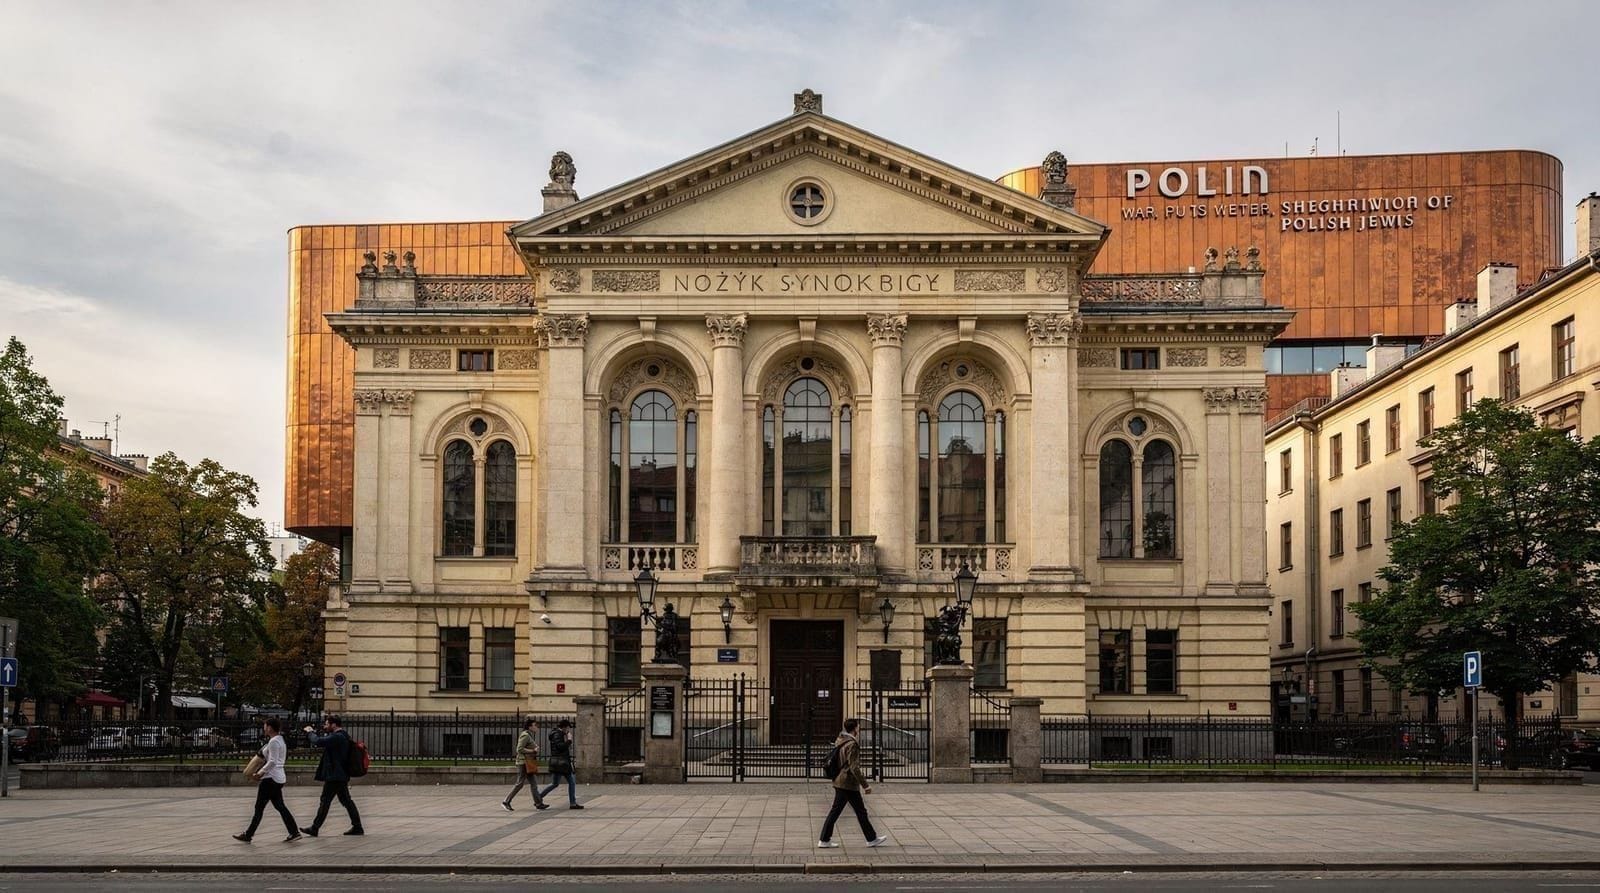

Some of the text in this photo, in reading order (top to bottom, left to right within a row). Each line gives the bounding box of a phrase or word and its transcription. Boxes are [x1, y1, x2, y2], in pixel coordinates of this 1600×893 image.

[1427, 195, 1453, 209] OF
[1281, 214, 1414, 231] POLISH JEWIS
[1467, 657, 1477, 683] P
